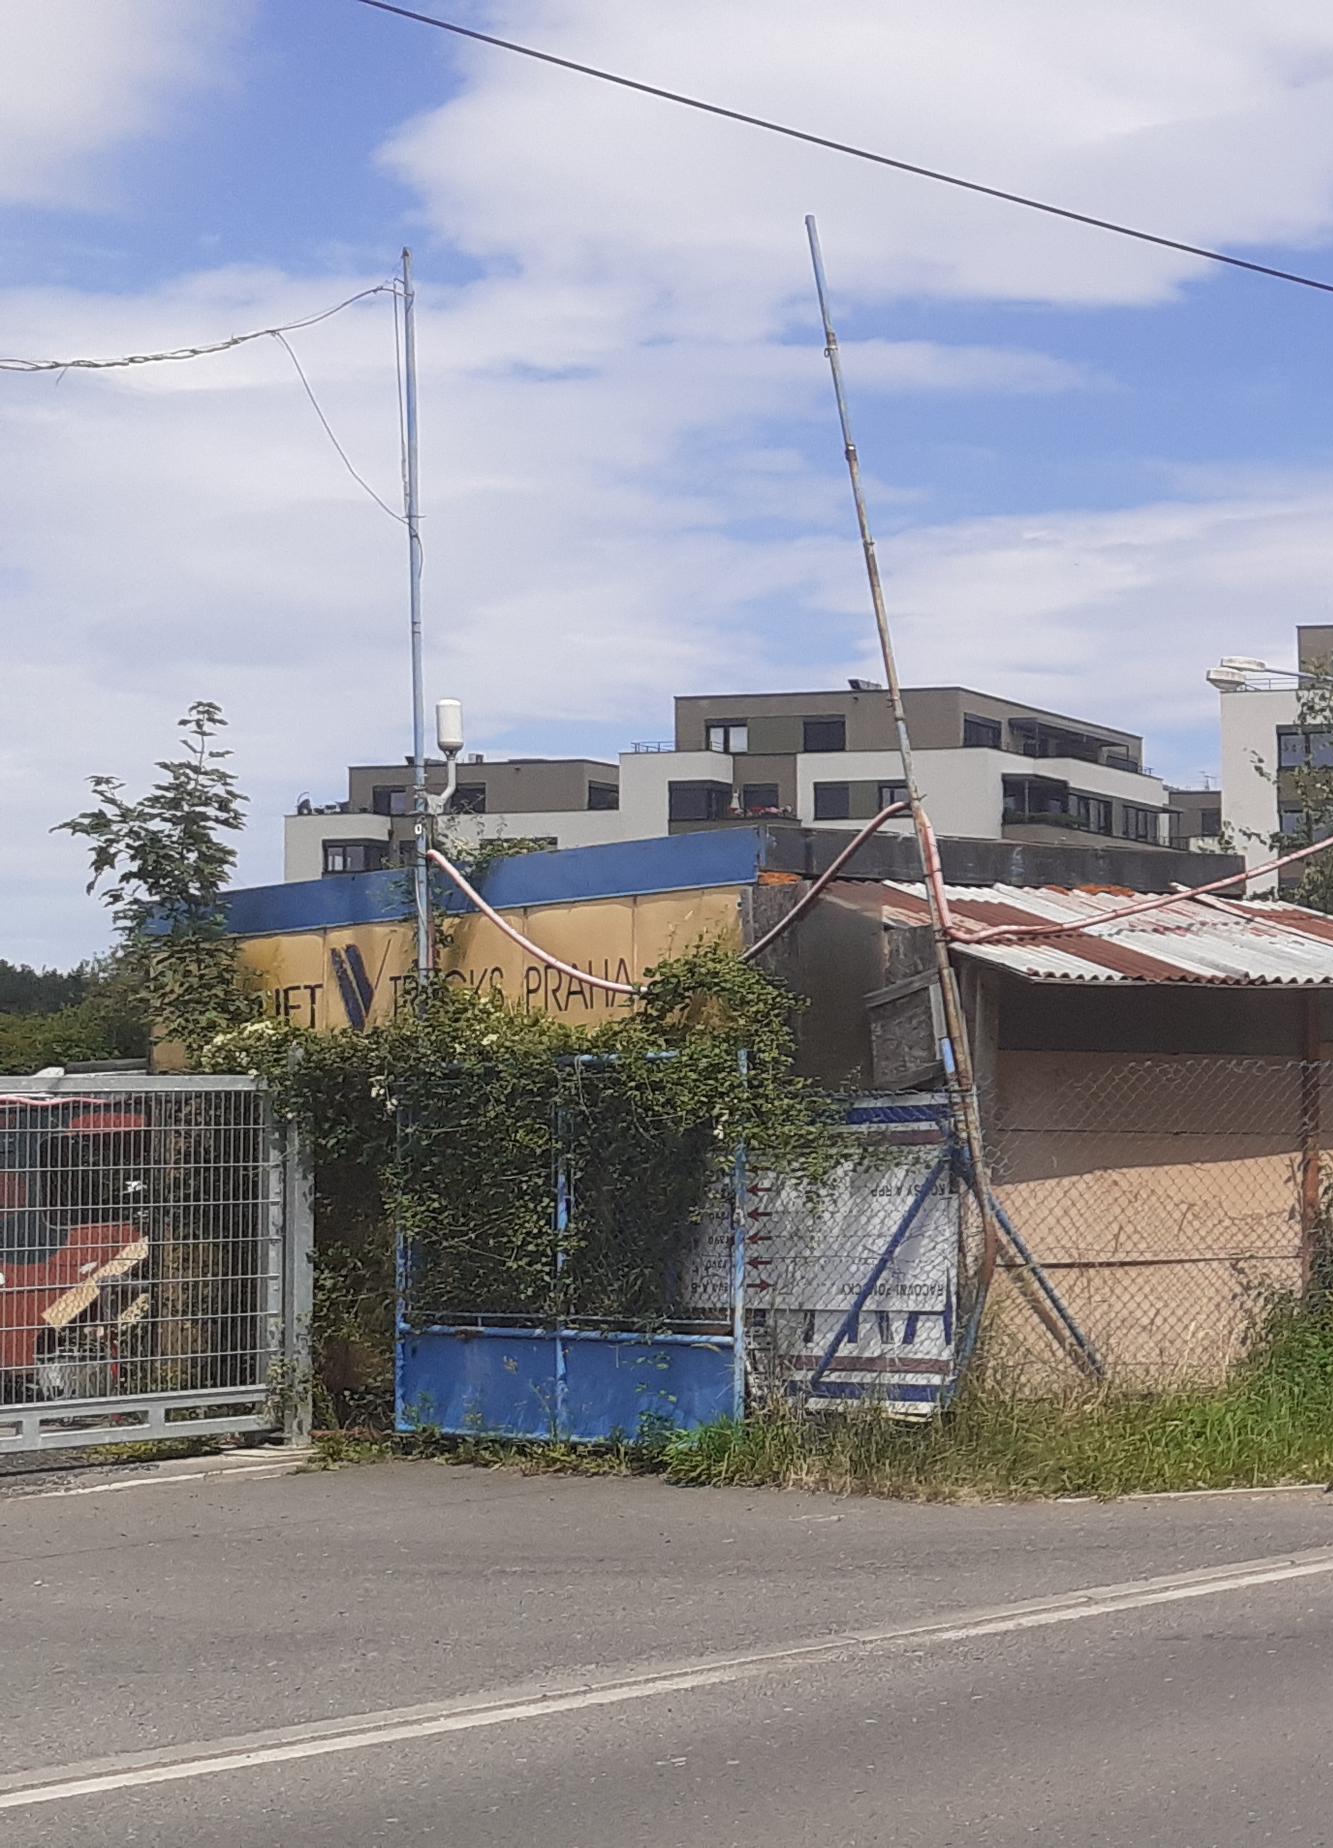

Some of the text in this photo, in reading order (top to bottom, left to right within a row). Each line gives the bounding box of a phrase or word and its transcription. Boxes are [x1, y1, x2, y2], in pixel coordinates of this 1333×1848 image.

[273, 957, 636, 1029] IFT TRKS PRAHA
